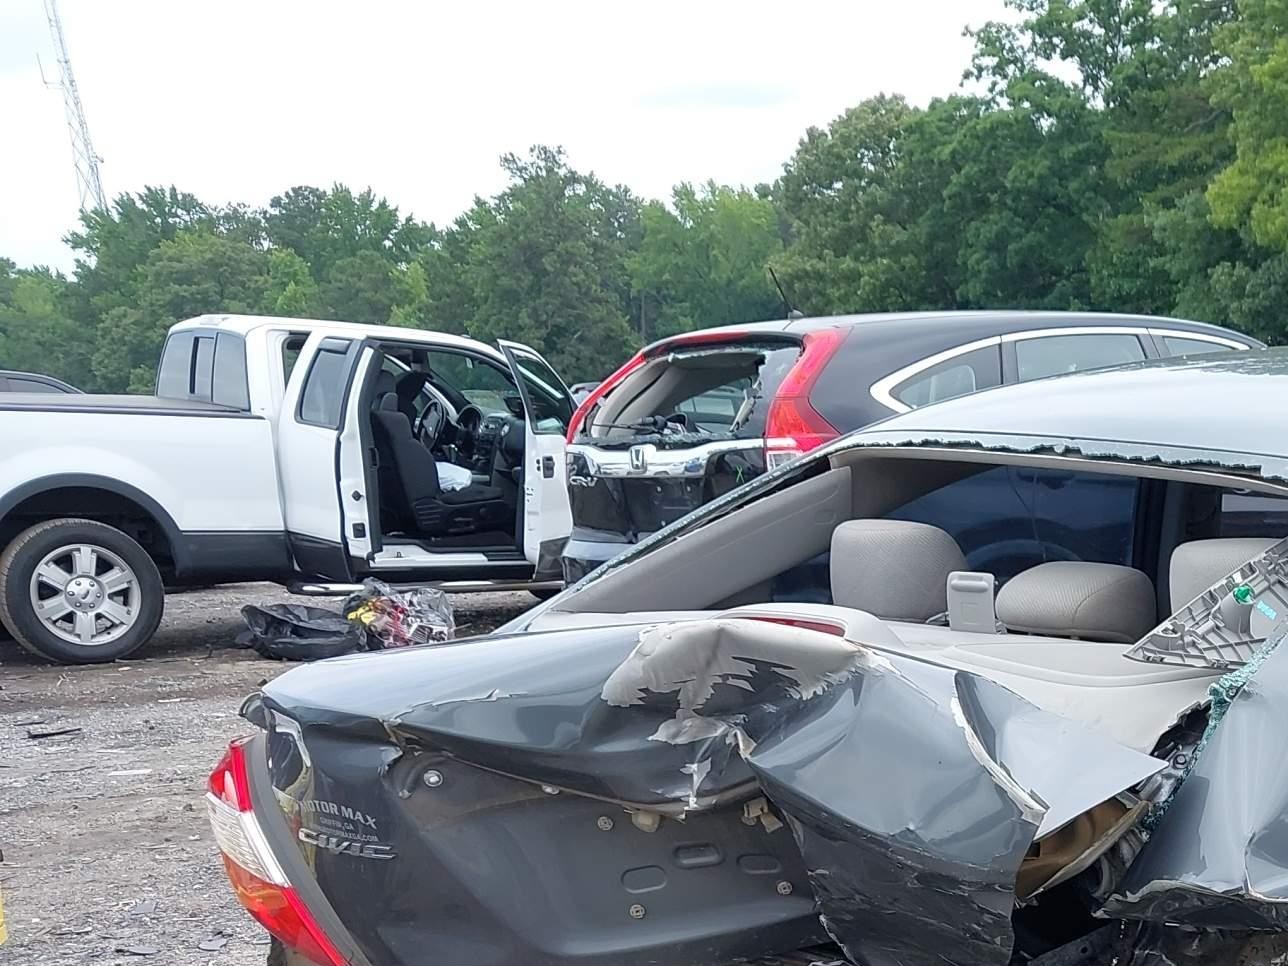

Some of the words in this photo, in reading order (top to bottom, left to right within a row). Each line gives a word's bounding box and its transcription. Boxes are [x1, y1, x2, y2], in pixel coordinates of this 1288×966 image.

[299, 800, 339, 816] MOTOR
[341, 806, 377, 829] MAX
[298, 827, 397, 859] CIVIC
